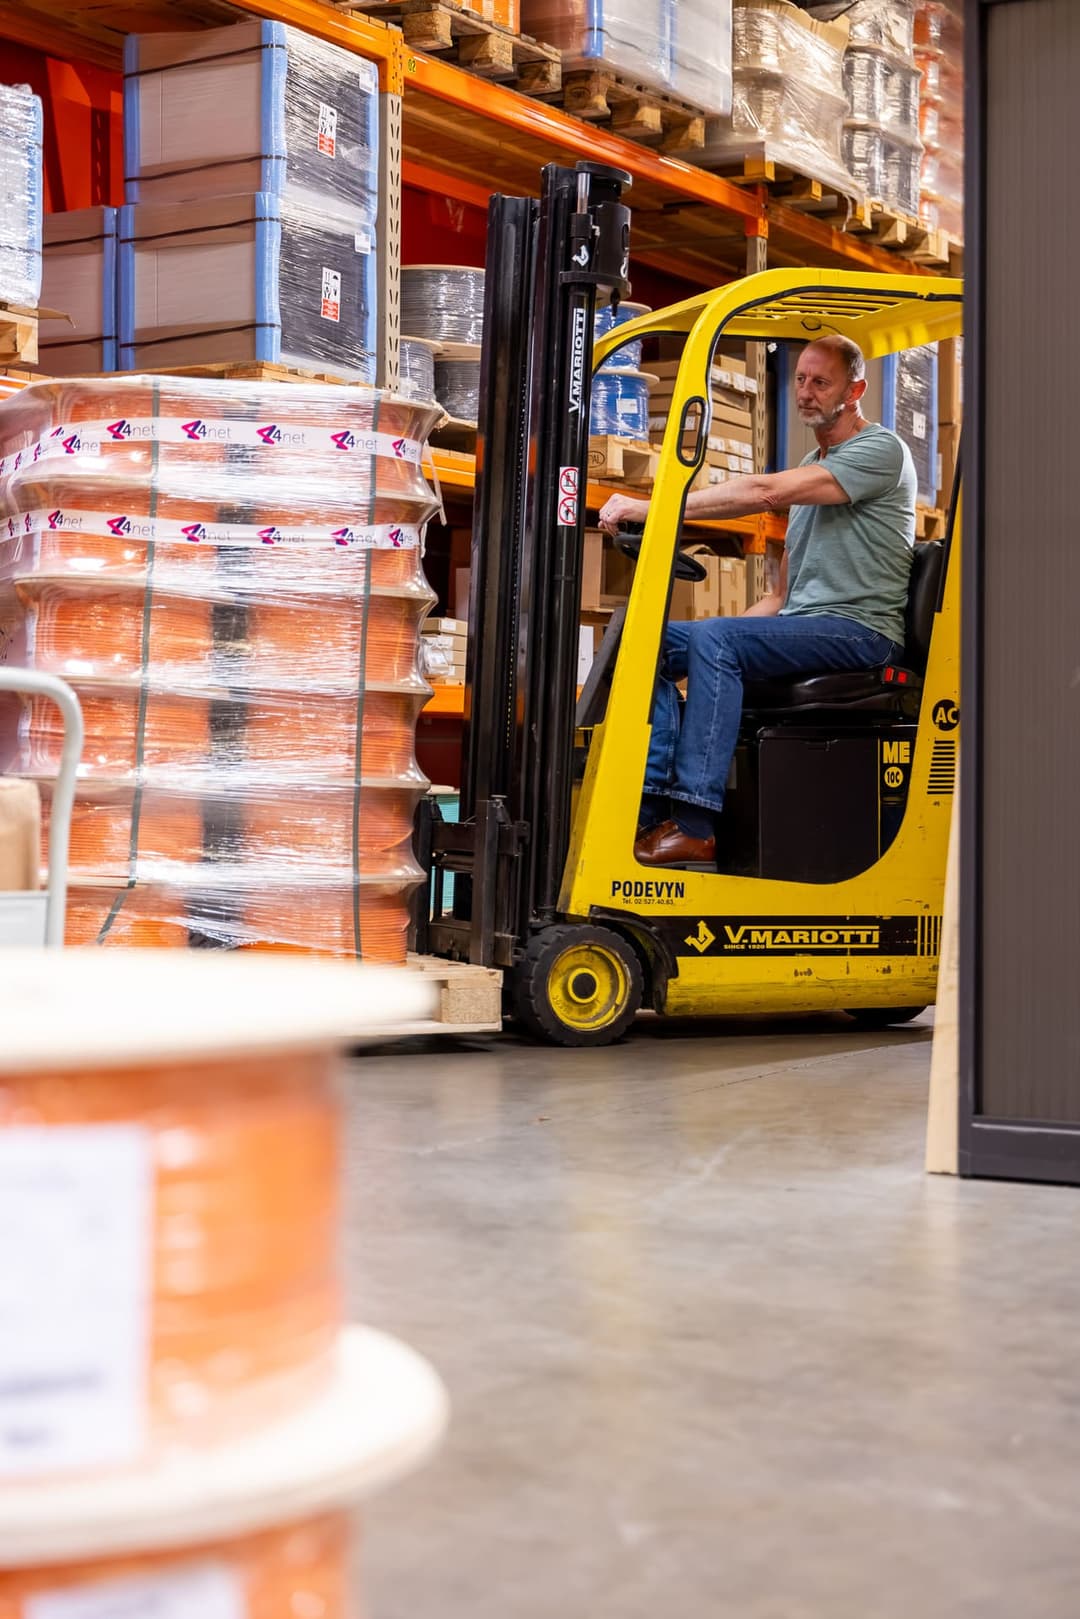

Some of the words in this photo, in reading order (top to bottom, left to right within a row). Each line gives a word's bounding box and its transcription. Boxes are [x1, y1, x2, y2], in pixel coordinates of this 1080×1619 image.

[569, 308, 586, 413] V.MARIOTTI
[935, 707, 958, 724] AC
[883, 741, 910, 764] ME
[886, 771, 900, 784] 10C
[612, 880, 685, 898] PODEVYN
[724, 925, 880, 948] V.MARIOTTI
